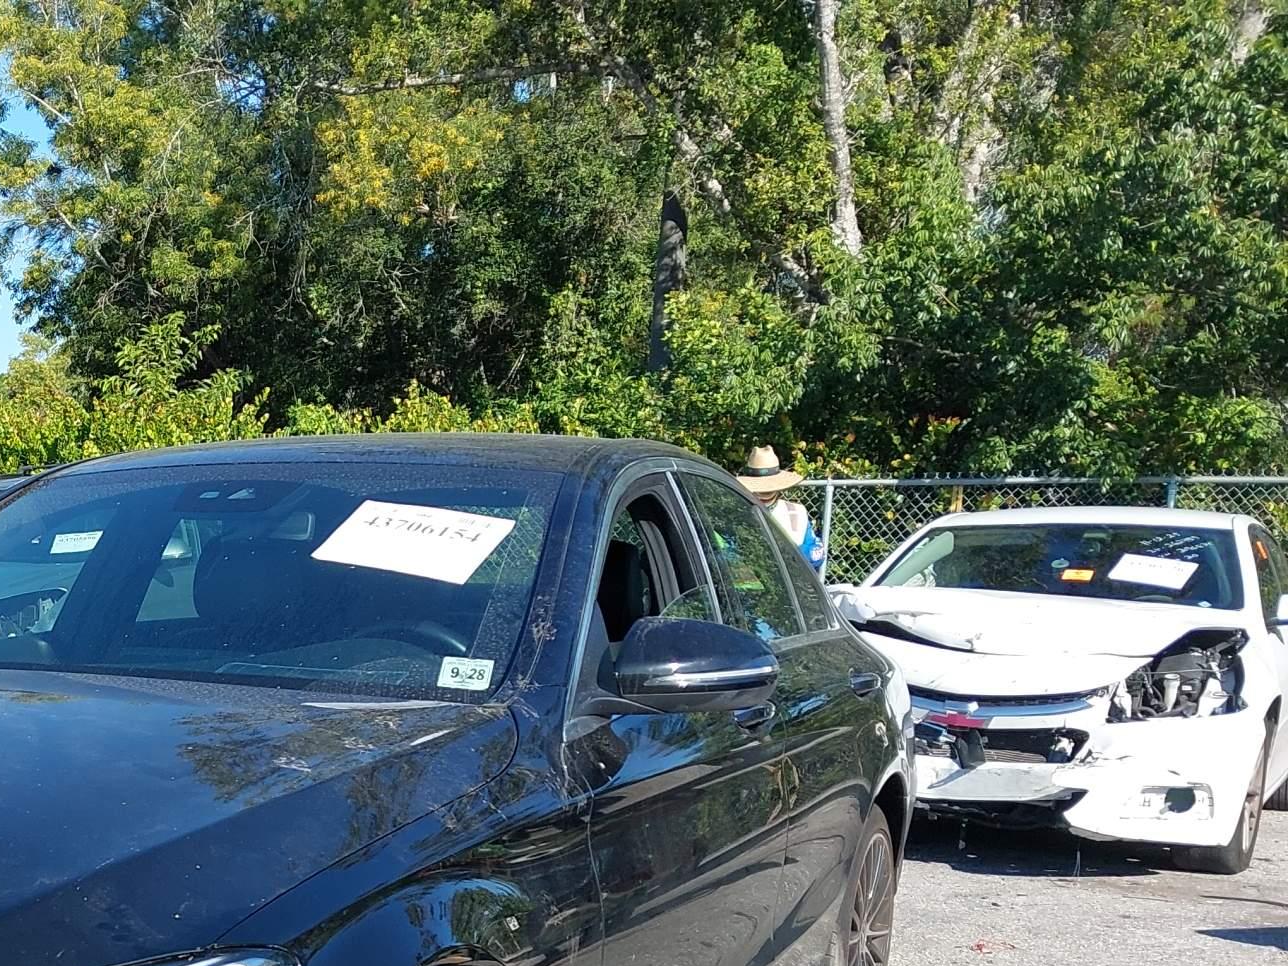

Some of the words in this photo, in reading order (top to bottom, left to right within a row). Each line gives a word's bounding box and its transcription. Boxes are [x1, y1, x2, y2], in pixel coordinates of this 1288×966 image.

[363, 516, 481, 542] 43706154
[450, 666, 460, 679] 9
[467, 668, 486, 681] 28
